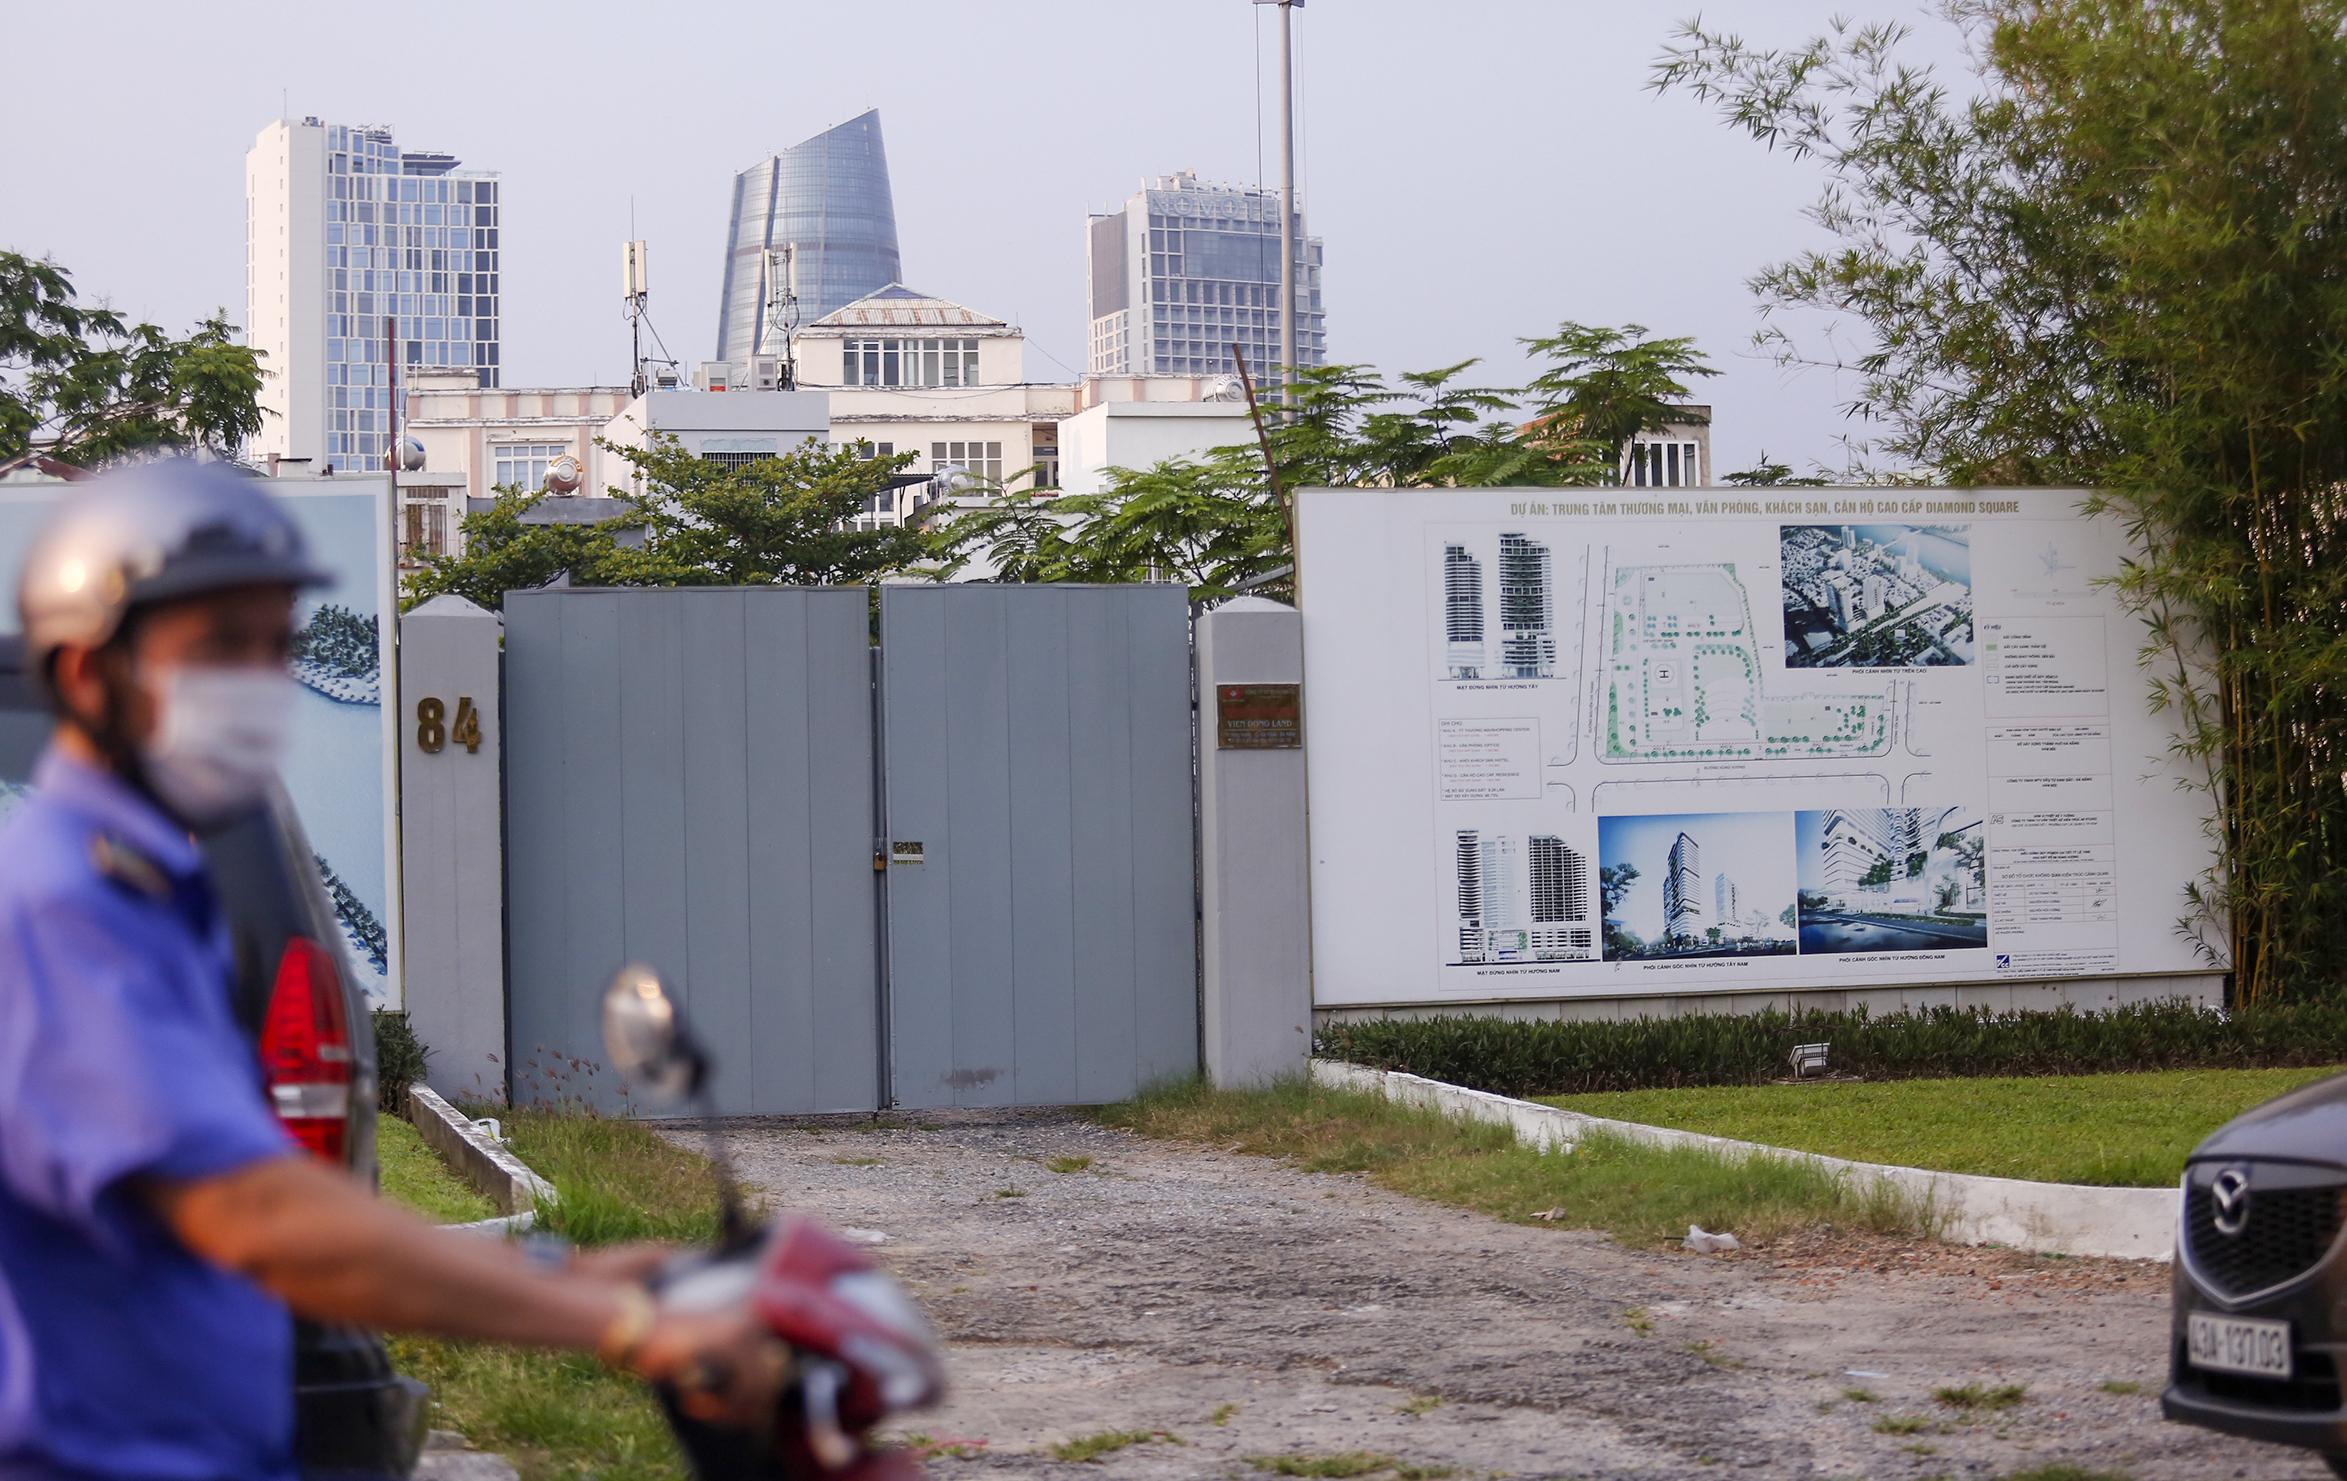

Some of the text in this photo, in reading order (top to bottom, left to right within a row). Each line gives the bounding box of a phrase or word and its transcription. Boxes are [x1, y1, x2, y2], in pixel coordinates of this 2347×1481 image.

[1148, 191, 1282, 223] NOVOTE
[1511, 498, 2019, 518] DỰ ÁN: TRUNG TÂM THƯƠNG MẠI, VĂN PHÒNG, KHÁCH SẠN, CĂN HỘ CAO CẤP DIAMOND SQUARE
[417, 696, 482, 754] 84
